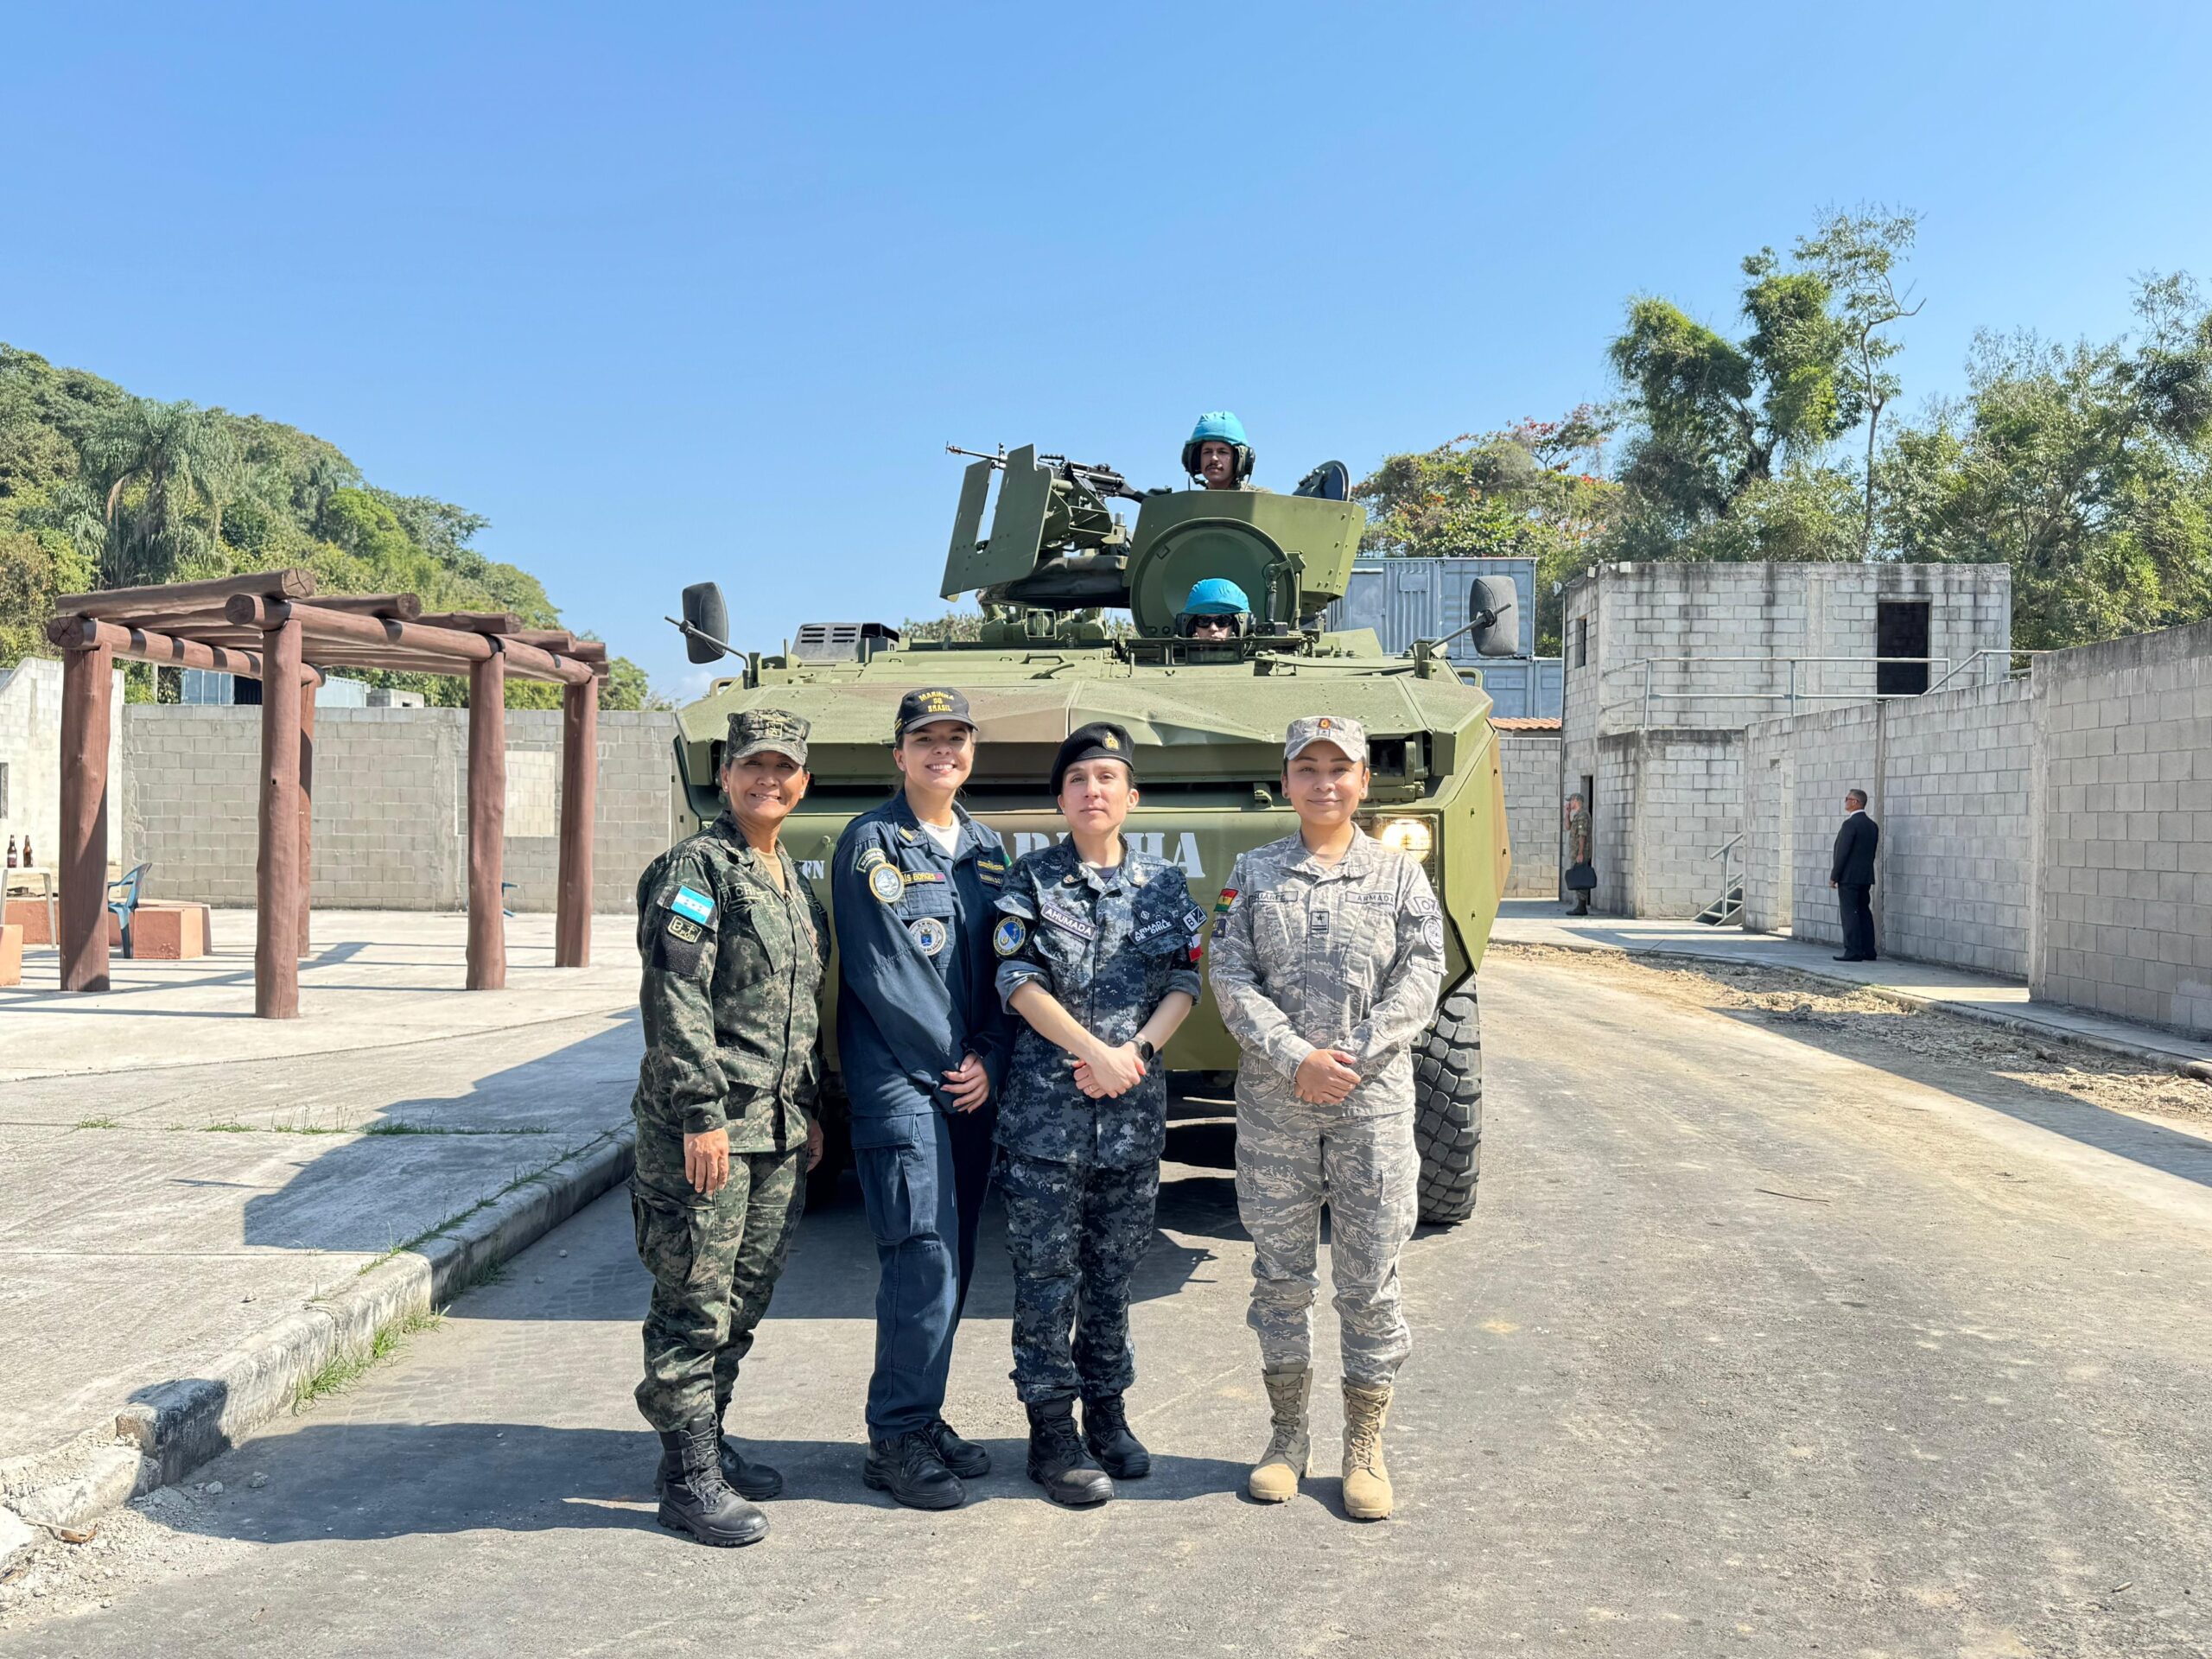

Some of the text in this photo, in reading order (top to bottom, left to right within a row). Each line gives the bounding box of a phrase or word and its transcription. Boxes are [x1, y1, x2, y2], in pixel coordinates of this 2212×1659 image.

[918, 691, 954, 702] MARINHA
[1357, 894, 1394, 903] ARMADA
[1045, 908, 1092, 936] AHUMADA
[1135, 918, 1168, 936] ARMADA
